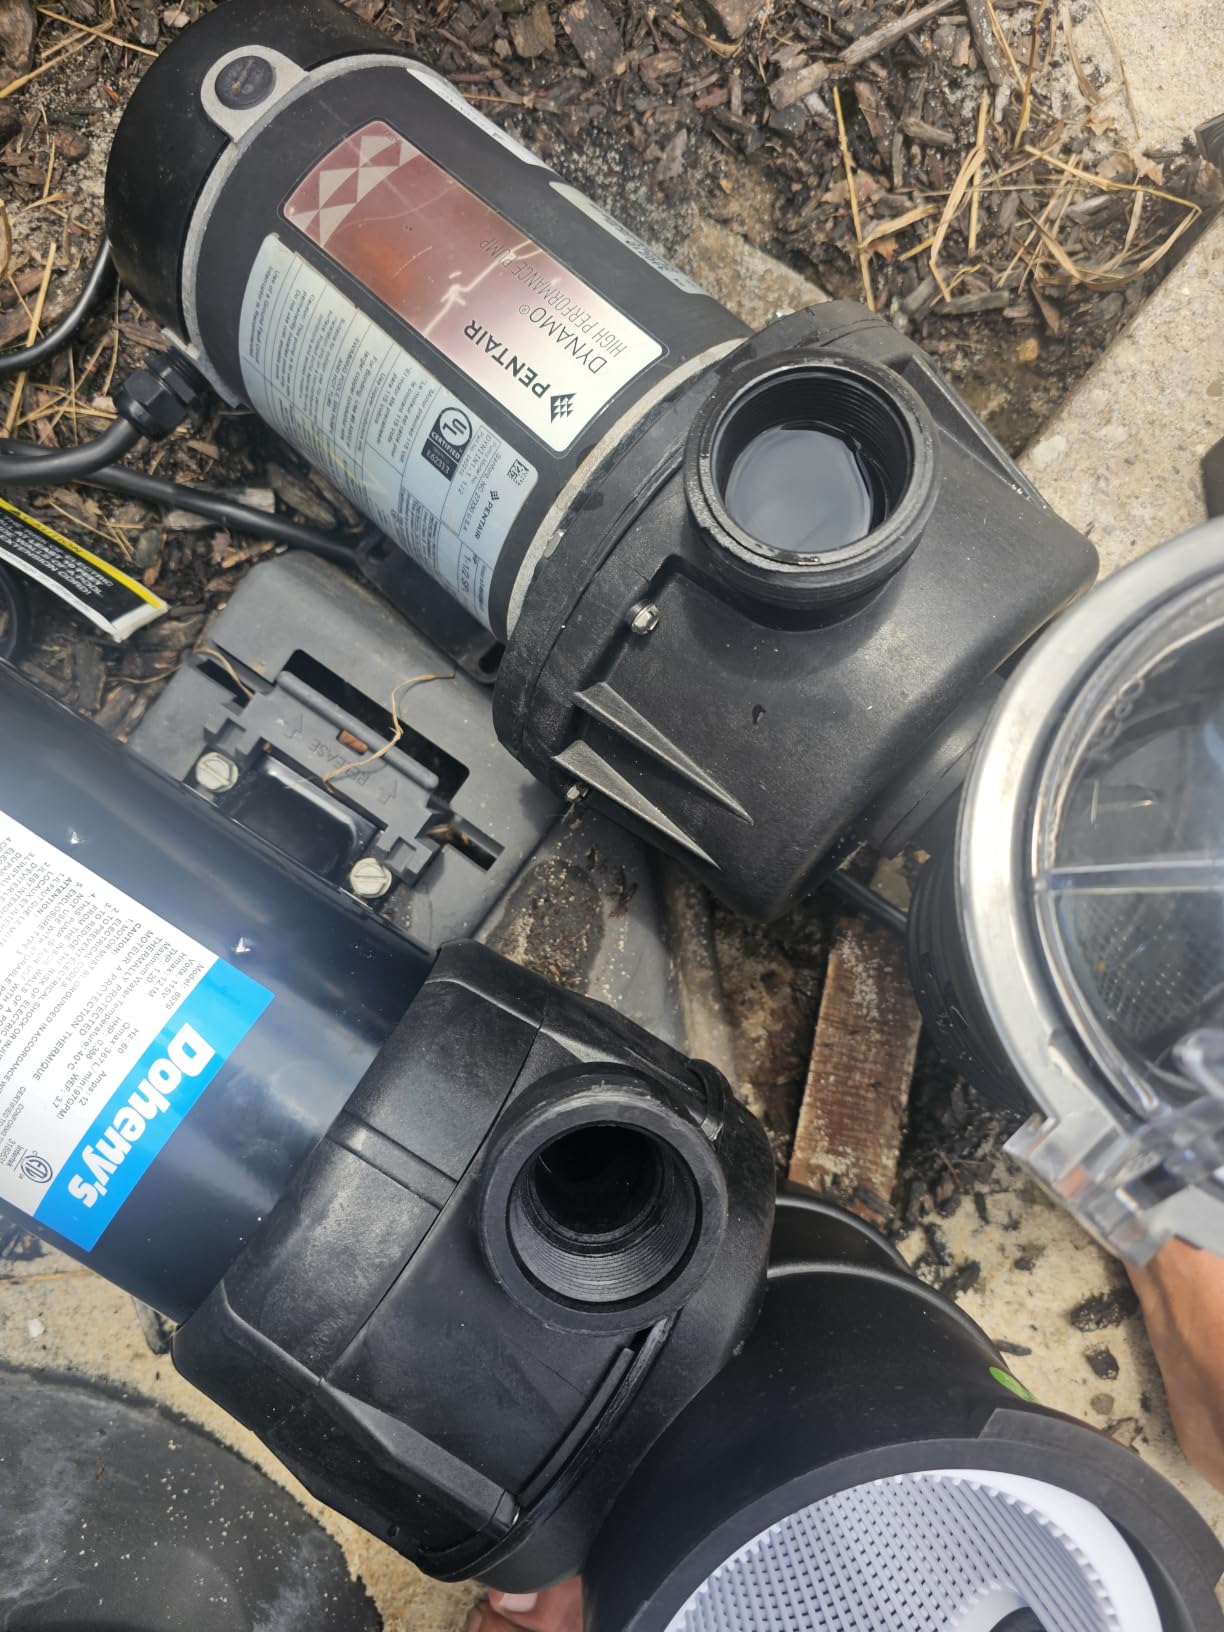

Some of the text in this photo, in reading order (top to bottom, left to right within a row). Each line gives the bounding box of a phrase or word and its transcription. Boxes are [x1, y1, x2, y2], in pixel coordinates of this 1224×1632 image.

[477, 232, 628, 359] HIGH PERFORMANCE PUMP
[459, 317, 552, 399] PENTAIR
[441, 411, 467, 444] UL
[430, 430, 460, 460] CERTIFIED
[473, 499, 493, 540] PENTAIR
[309, 739, 370, 786] REEASE
[24, 871, 40, 888] EST
[25, 869, 54, 900] LOCAUX
[35, 882, 55, 902] FAUT
[17, 896, 29, 908] ET
[21, 898, 39, 917] QUE
[35, 887, 77, 932] ENCLOSURE
[72, 898, 91, 916] THIS
[76, 903, 98, 926] FROM
[93, 908, 106, 921] TO
[54, 915, 75, 938] PUMP
[101, 913, 113, 926] TO
[3, 891, 84, 985] NOT USE WITH TORABLE
[20, 929, 39, 950] TYPE
[62, 924, 79, 942] THE
[67, 919, 95, 951] REDUCE
[73, 923, 105, 958] PREVENT
[82, 917, 122, 961] ELECTRICAL
[103, 922, 128, 951] MOTOR
[110, 921, 142, 956] CAUTION:
[86, 948, 107, 971] MUST
[138, 940, 171, 976] Maximum
[19, 966, 43, 994] WALLS
[37, 967, 56, 986] RISK
[77, 935, 162, 1037] THERMALLY PROTECTED
[120, 974, 142, 999] Water
[144, 966, 160, 984] 1.20
[1, 981, 20, 1003] WITH
[10, 993, 23, 1007] OF
[28, 985, 40, 999] OF
[159, 978, 178, 999] 115V
[4, 1006, 13, 1014] A
[17, 1000, 41, 1028] SHOCK
[31, 928, 153, 1081] MOTEUR A PROTECTION THERMIQUE
[44, 979, 80, 1024] GROUNDED
[0, 998, 30, 1037] ELECTRIC
[37, 1021, 48, 1033] IN
[8, 1026, 22, 1040] OR
[2, 1029, 42, 1081] ACCORDANCE
[84, 1038, 104, 1061] 0.388
[116, 1041, 129, 1055] 60
[1, 1084, 27, 1118] CERTIFIED
[50, 1094, 63, 1109] 3.7
[77, 1095, 89, 1107] 12
[0, 1102, 24, 1137] CONFORMS
[63, 1020, 220, 1209] Doheny's
[4, 1143, 24, 1169] Intertek
